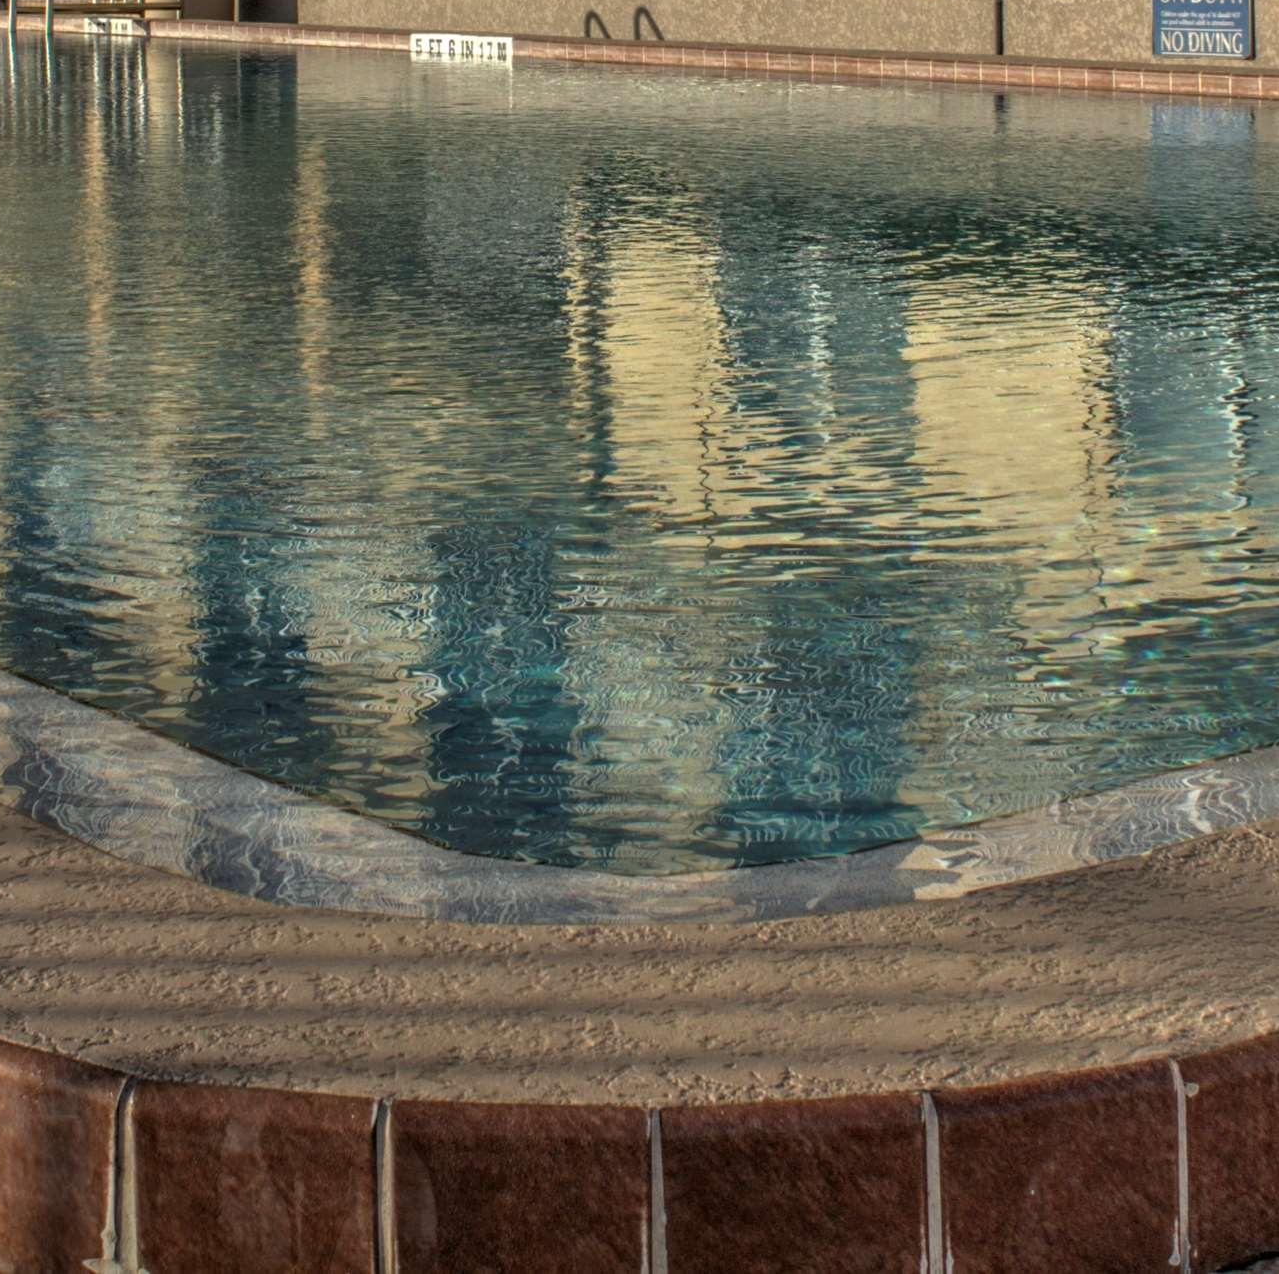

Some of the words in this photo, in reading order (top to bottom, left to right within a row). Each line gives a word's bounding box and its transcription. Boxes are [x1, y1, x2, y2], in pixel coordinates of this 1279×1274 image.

[415, 38, 422, 54] 5
[448, 39, 455, 57] 6
[461, 40, 474, 58] IN
[1160, 31, 1184, 52] NO
[1188, 31, 1243, 53] DIVING
